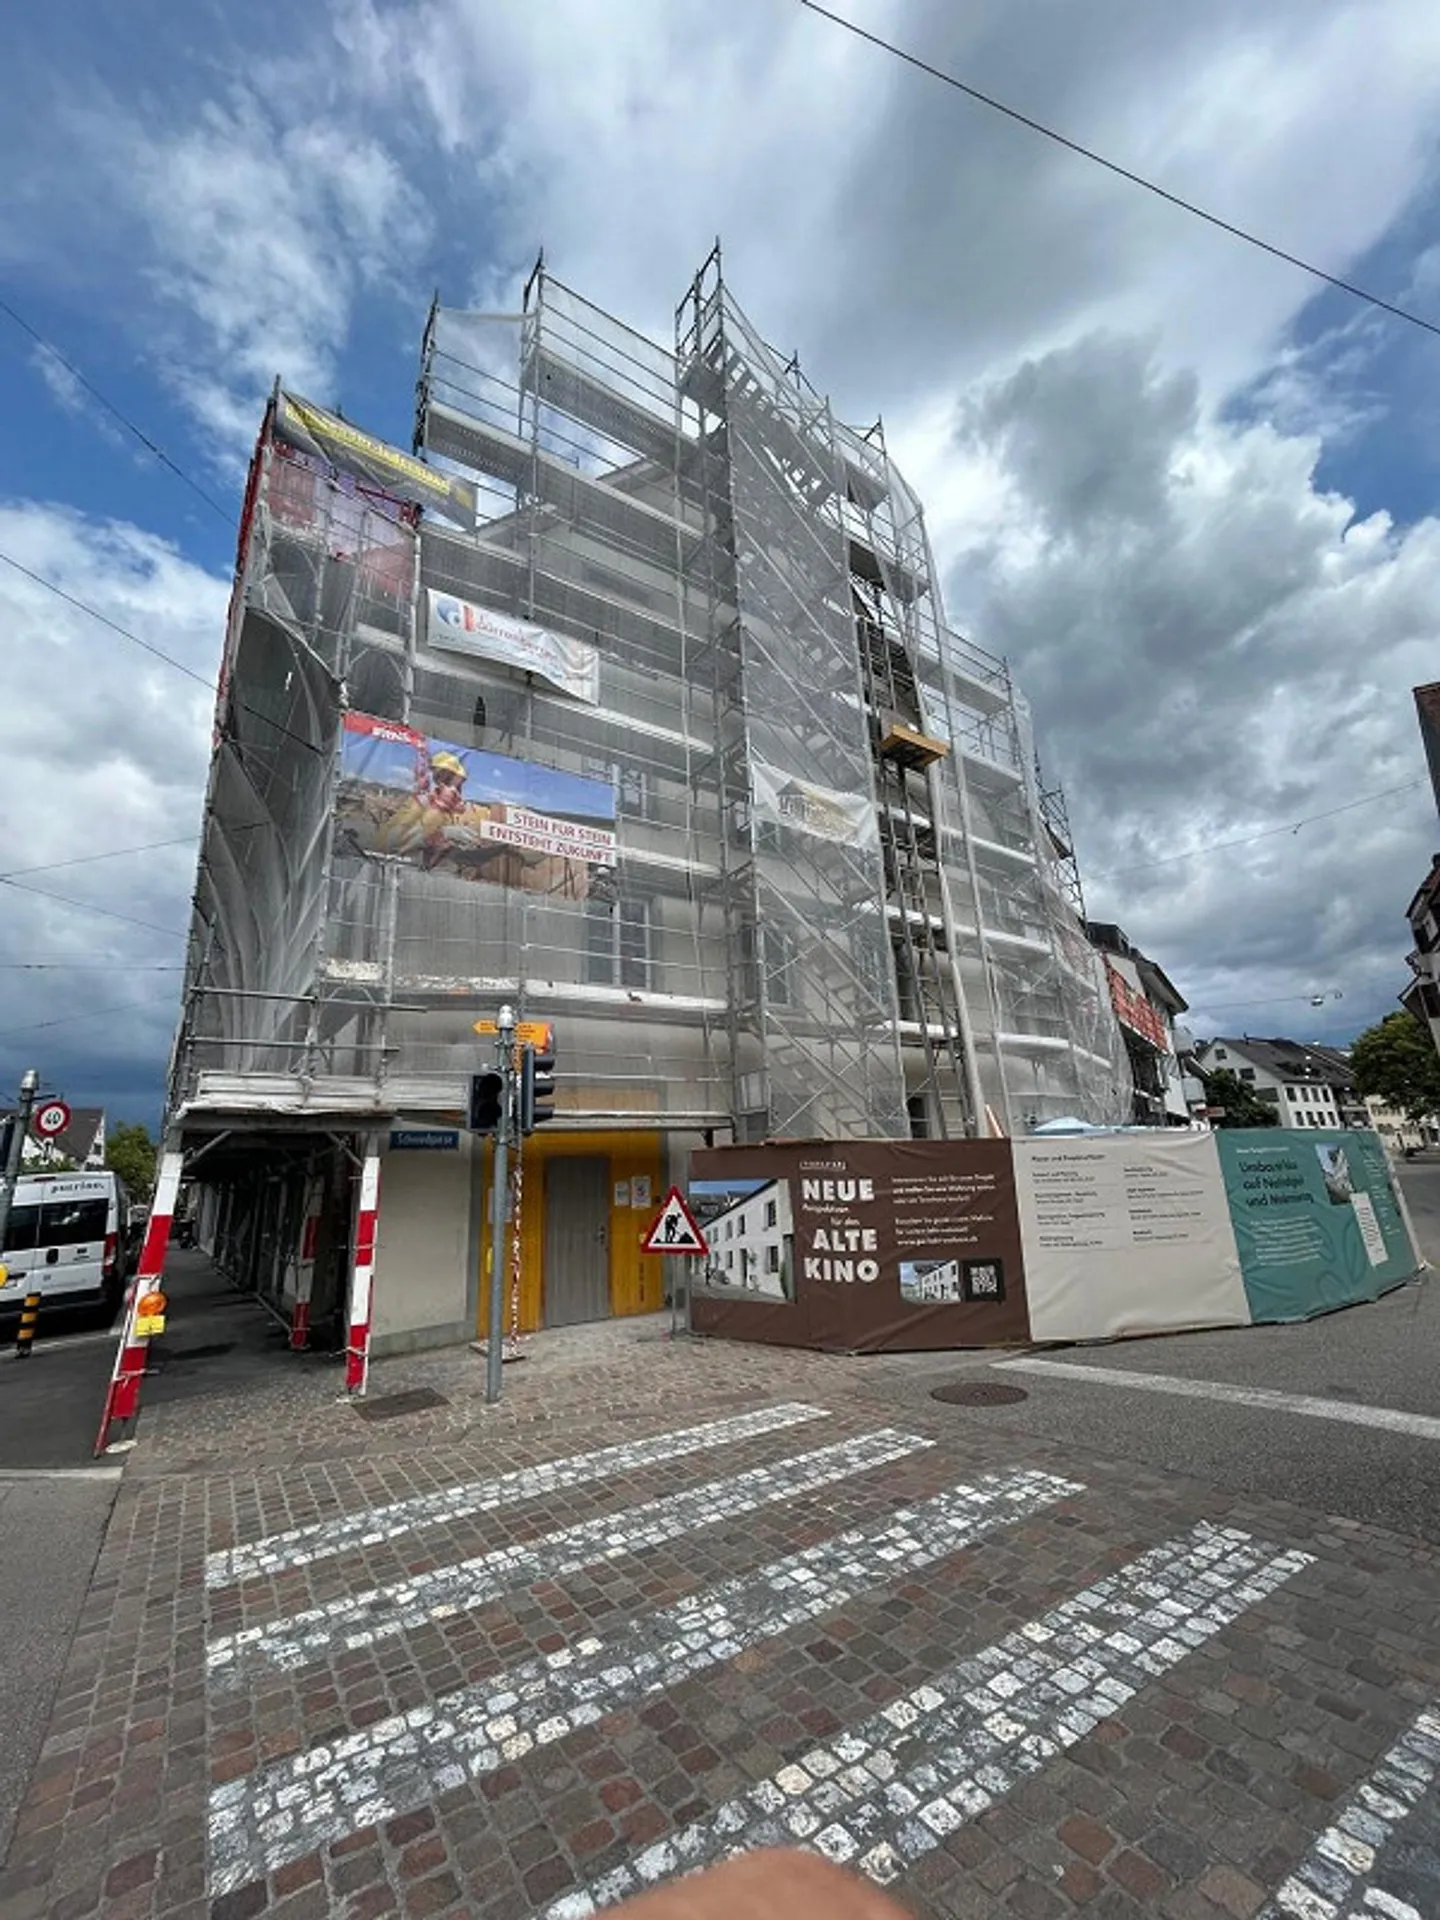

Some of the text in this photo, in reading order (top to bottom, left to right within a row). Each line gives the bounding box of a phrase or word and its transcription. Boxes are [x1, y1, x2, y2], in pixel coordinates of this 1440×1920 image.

[514, 812, 549, 832] STEIN
[578, 827, 612, 846] STEIN
[489, 825, 612, 862] ENTSTEHT ZUKUNFT
[801, 1177, 875, 1202] NEUE
[812, 1227, 878, 1252] ALTE
[803, 1256, 880, 1283] KINO
